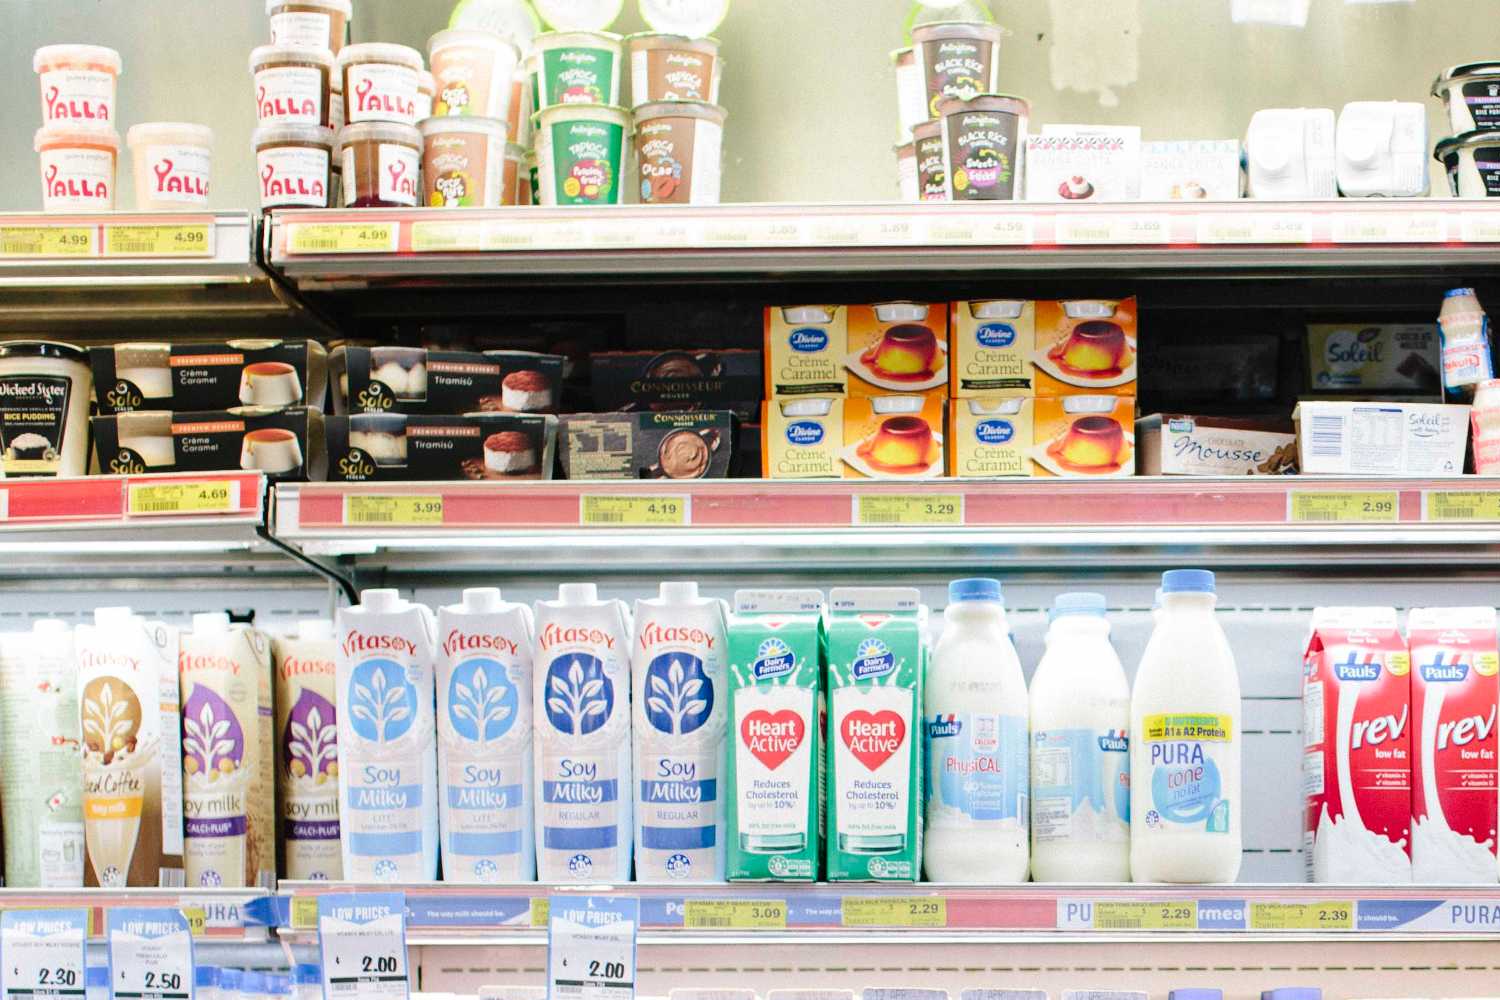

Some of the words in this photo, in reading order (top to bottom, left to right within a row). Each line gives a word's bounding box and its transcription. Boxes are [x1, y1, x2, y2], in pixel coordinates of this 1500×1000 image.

[45, 87, 108, 120] YALLA
[256, 87, 315, 116] YALLA
[59, 234, 88, 246] 4.99
[174, 231, 204, 243] 4.99
[359, 229, 388, 241] 4.99
[792, 333, 827, 345] Divine
[1329, 340, 1383, 364] Soleil
[789, 355, 829, 368] Crème
[780, 366, 836, 381] Caramel
[22, 413, 55, 421] PUDDING
[654, 413, 716, 422] CONNOISSEUR
[1174, 436, 1261, 462] Mousse
[777, 459, 833, 473] Caramel
[198, 487, 227, 500] 4.69
[413, 502, 442, 514] 3.99
[648, 504, 676, 515] 4.19
[925, 504, 954, 515] 3.29
[1363, 502, 1392, 513] 2.99
[540, 622, 614, 652] Vitasoy
[1339, 665, 1377, 679] Pauls
[749, 720, 795, 736] Heart
[849, 720, 896, 736] Heart
[1197, 727, 1226, 737] Protein
[751, 737, 797, 752] Active
[851, 737, 898, 752] Active
[1151, 743, 1204, 765] PURA
[363, 766, 400, 785] Soy
[464, 766, 501, 785] Soy
[753, 780, 790, 788] Reduces
[358, 786, 406, 809] Milky
[552, 780, 602, 803] Milky
[746, 791, 798, 799] Cholesterol
[657, 810, 698, 820] REGULAR
[752, 909, 781, 919] 3.09
[910, 904, 939, 914] 2.29
[1162, 909, 1191, 919] 2.29
[1318, 911, 1348, 921] 2.39
[563, 911, 585, 924] LOW
[587, 910, 623, 924] PRICES
[362, 956, 397, 973] 2.00
[589, 961, 625, 979] 2.00
[39, 969, 77, 986] 2.30
[145, 973, 181, 991] 2.50
